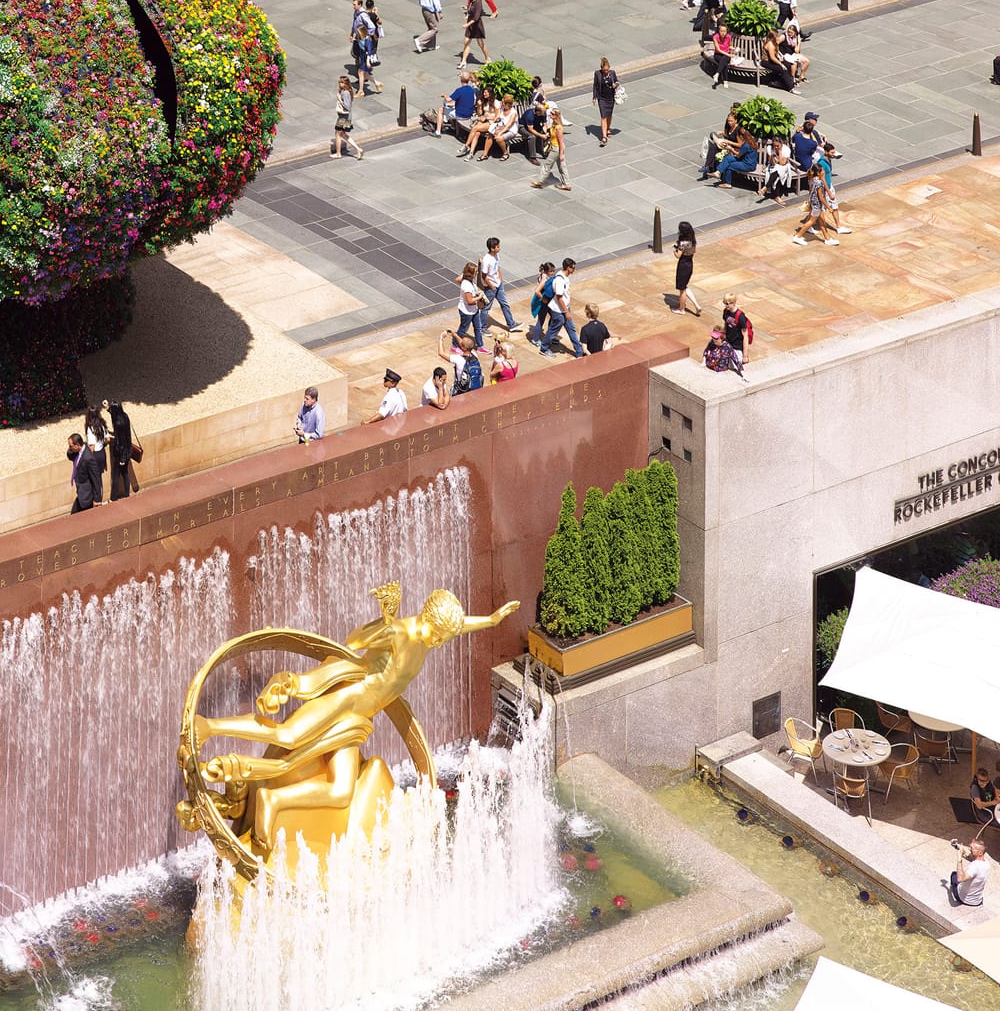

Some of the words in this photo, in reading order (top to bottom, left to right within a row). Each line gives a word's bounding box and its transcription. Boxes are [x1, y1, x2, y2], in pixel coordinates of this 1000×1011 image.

[18, 528, 129, 570] TEACHER
[157, 512, 180, 526] IN
[207, 481, 277, 511] EVERY
[302, 462, 339, 480] ART
[363, 424, 459, 460] BROUGHT
[482, 403, 517, 422] THE
[541, 383, 589, 404] FIRE
[106, 540, 129, 555] TO
[156, 498, 261, 538] MORTALS
[286, 488, 294, 497] A
[317, 458, 384, 486] MEANS
[409, 444, 430, 457] TO
[452, 411, 532, 443] MIGHTY
[894, 474, 992, 524] ROCKEFELLER
[917, 468, 944, 491] THE
